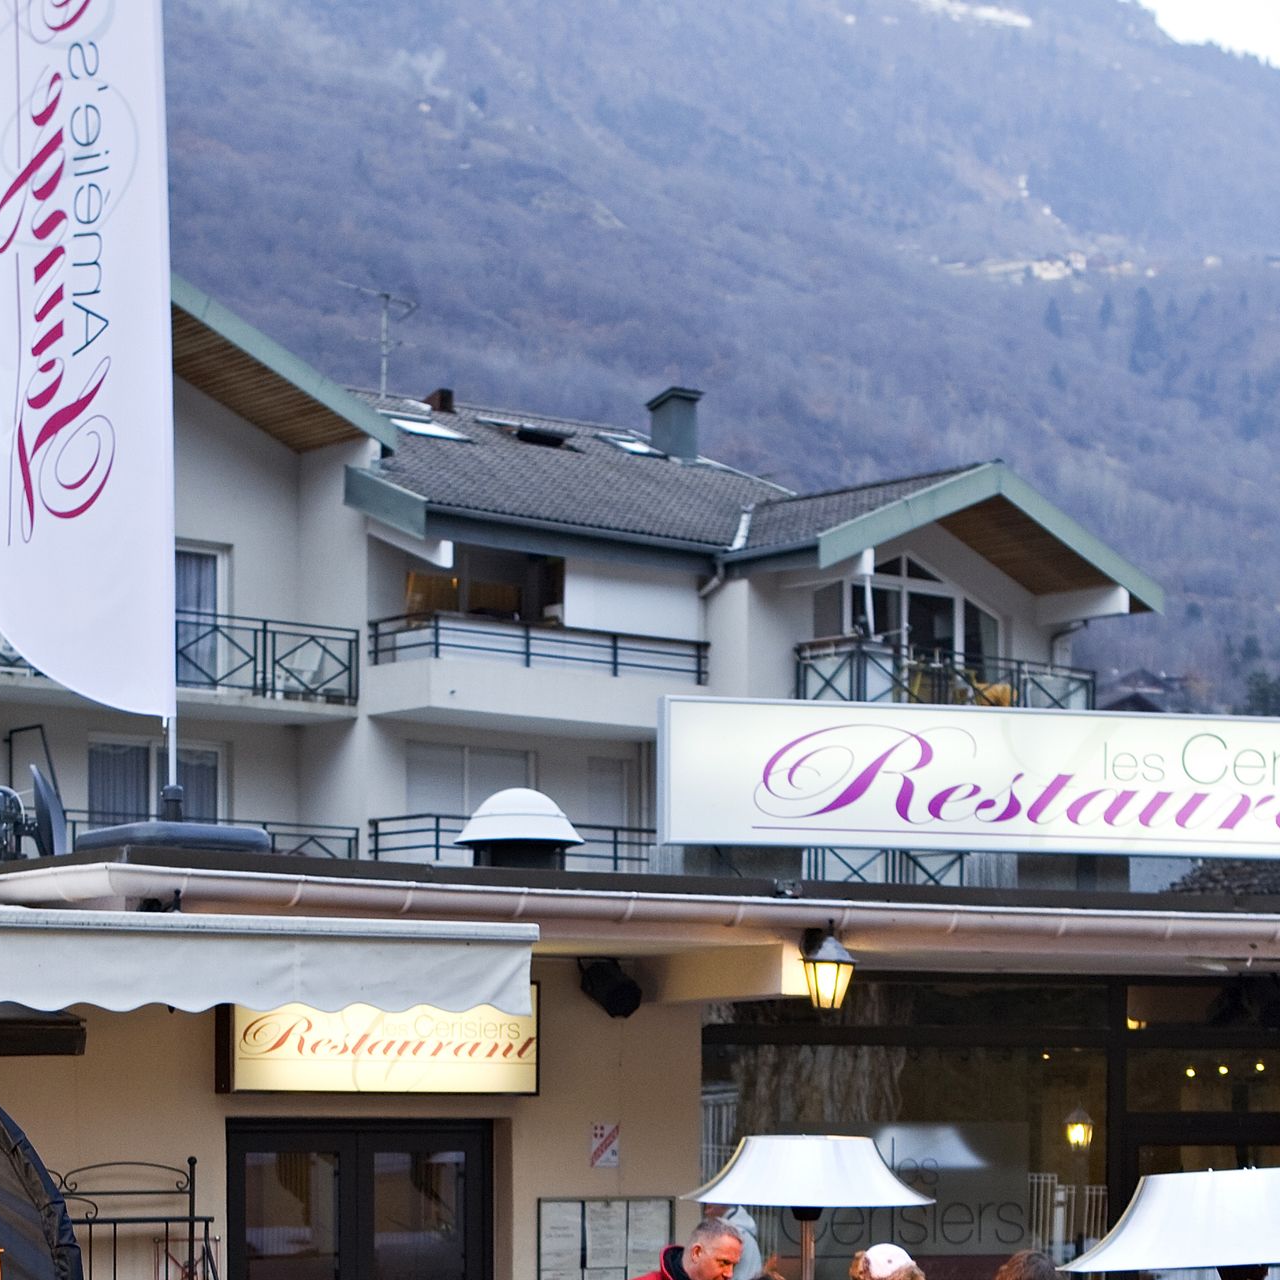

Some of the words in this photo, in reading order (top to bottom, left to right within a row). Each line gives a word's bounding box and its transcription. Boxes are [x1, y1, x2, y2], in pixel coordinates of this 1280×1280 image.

[1103, 741, 1166, 783] les
[239, 1011, 537, 1059] Restaurant
[414, 1014, 521, 1040] Cerisiers
